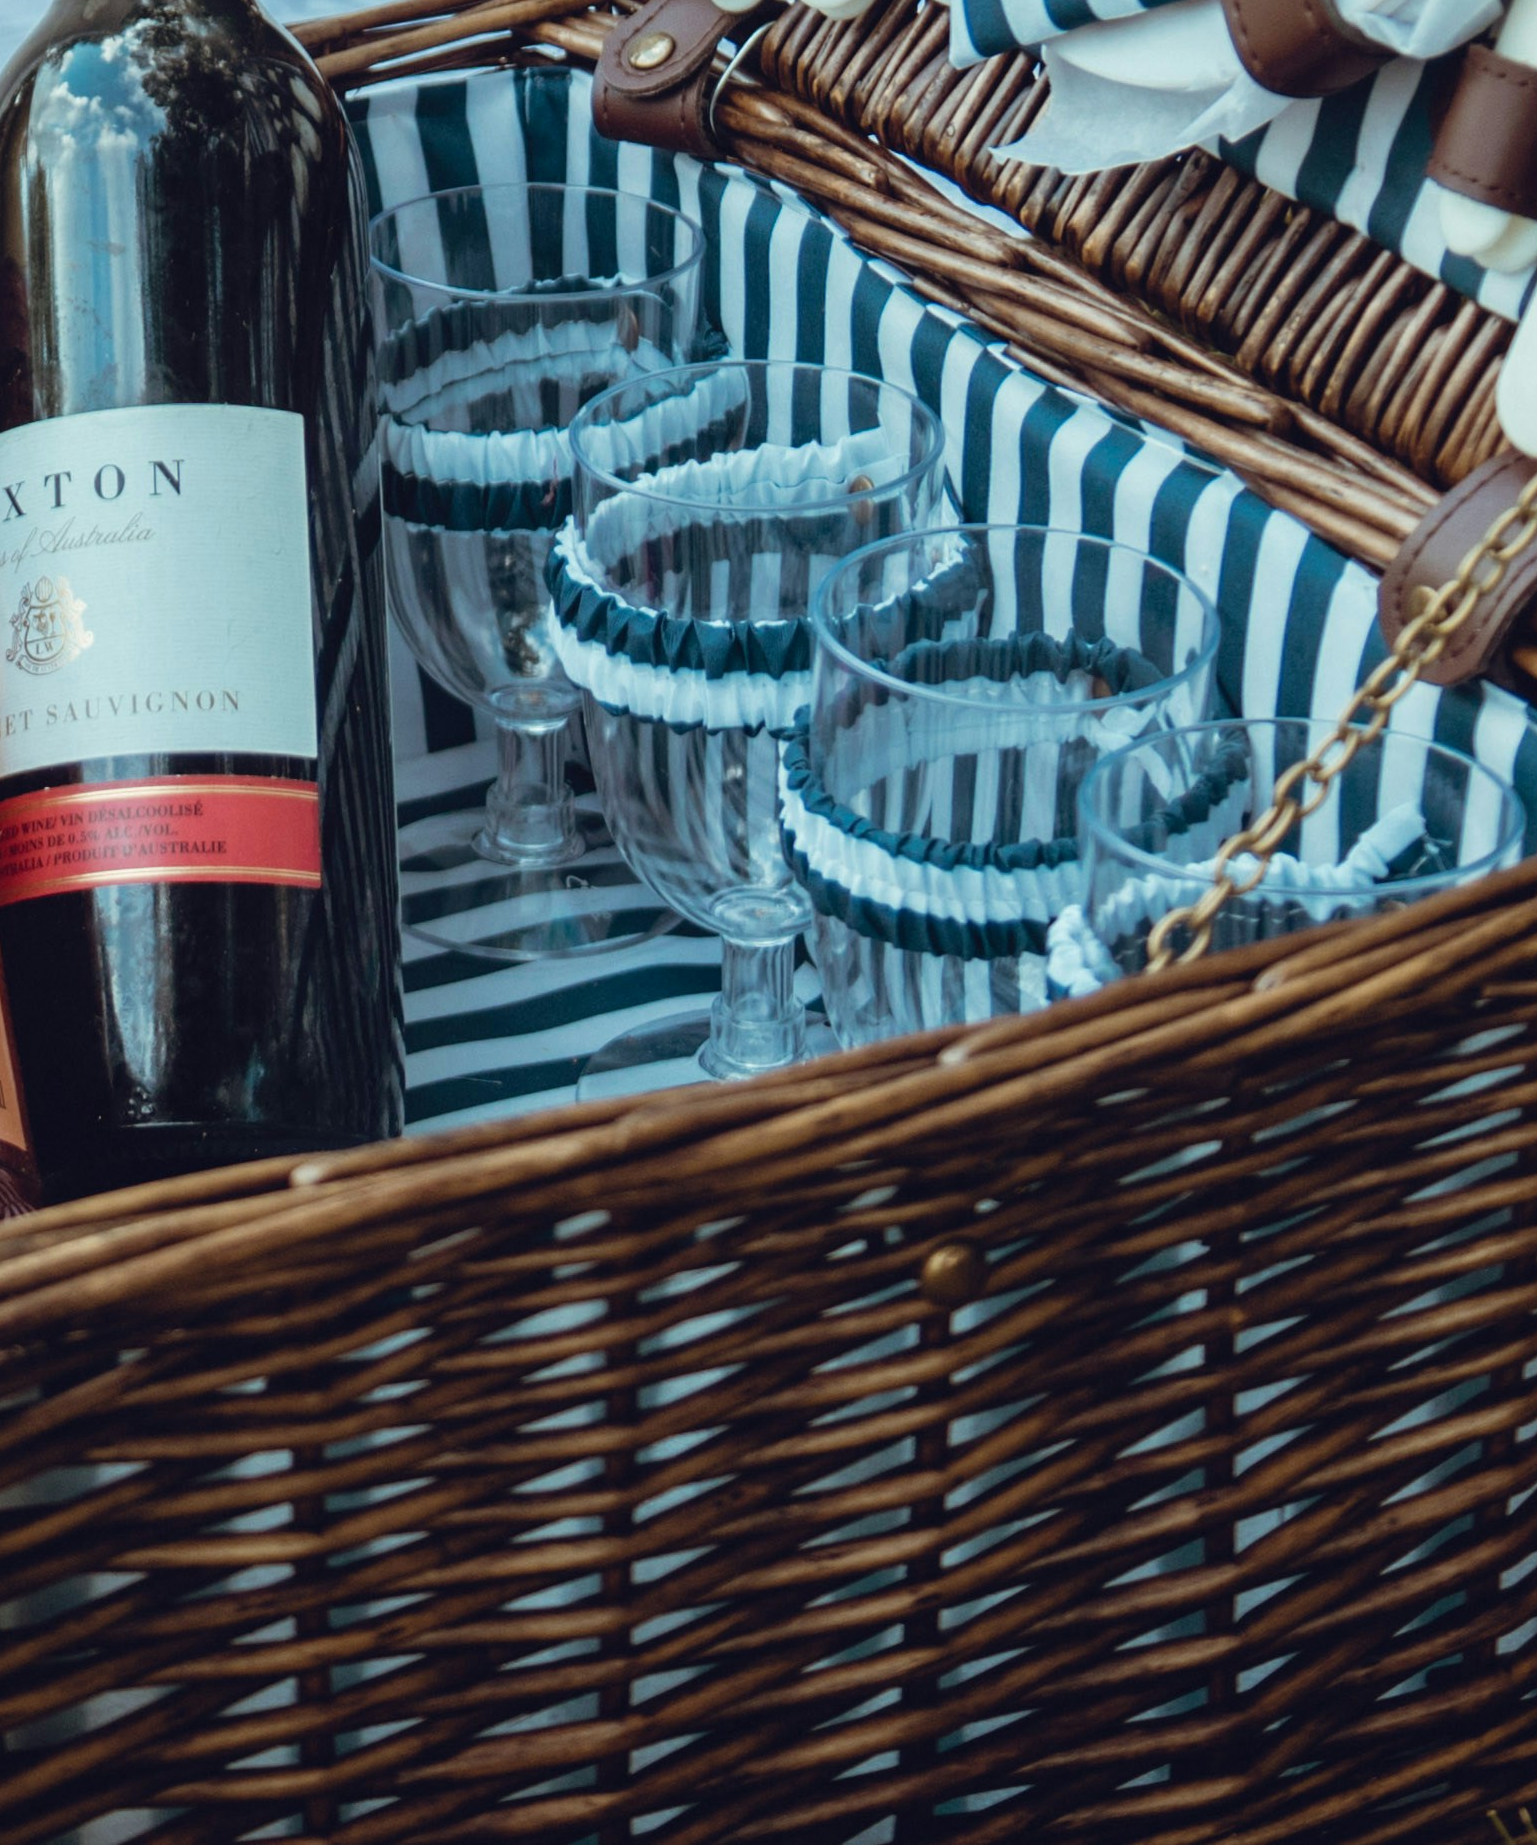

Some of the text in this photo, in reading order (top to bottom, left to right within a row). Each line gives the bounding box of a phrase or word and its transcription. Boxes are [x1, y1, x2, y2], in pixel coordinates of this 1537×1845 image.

[11, 526, 39, 573] of
[30, 510, 156, 557] Australia
[45, 690, 241, 729] SAUVIGNON
[59, 809, 84, 827] VIN
[87, 801, 204, 823] DÉSALCOOLISÉ
[47, 834, 65, 848] DE
[53, 844, 119, 866] PRODUIT
